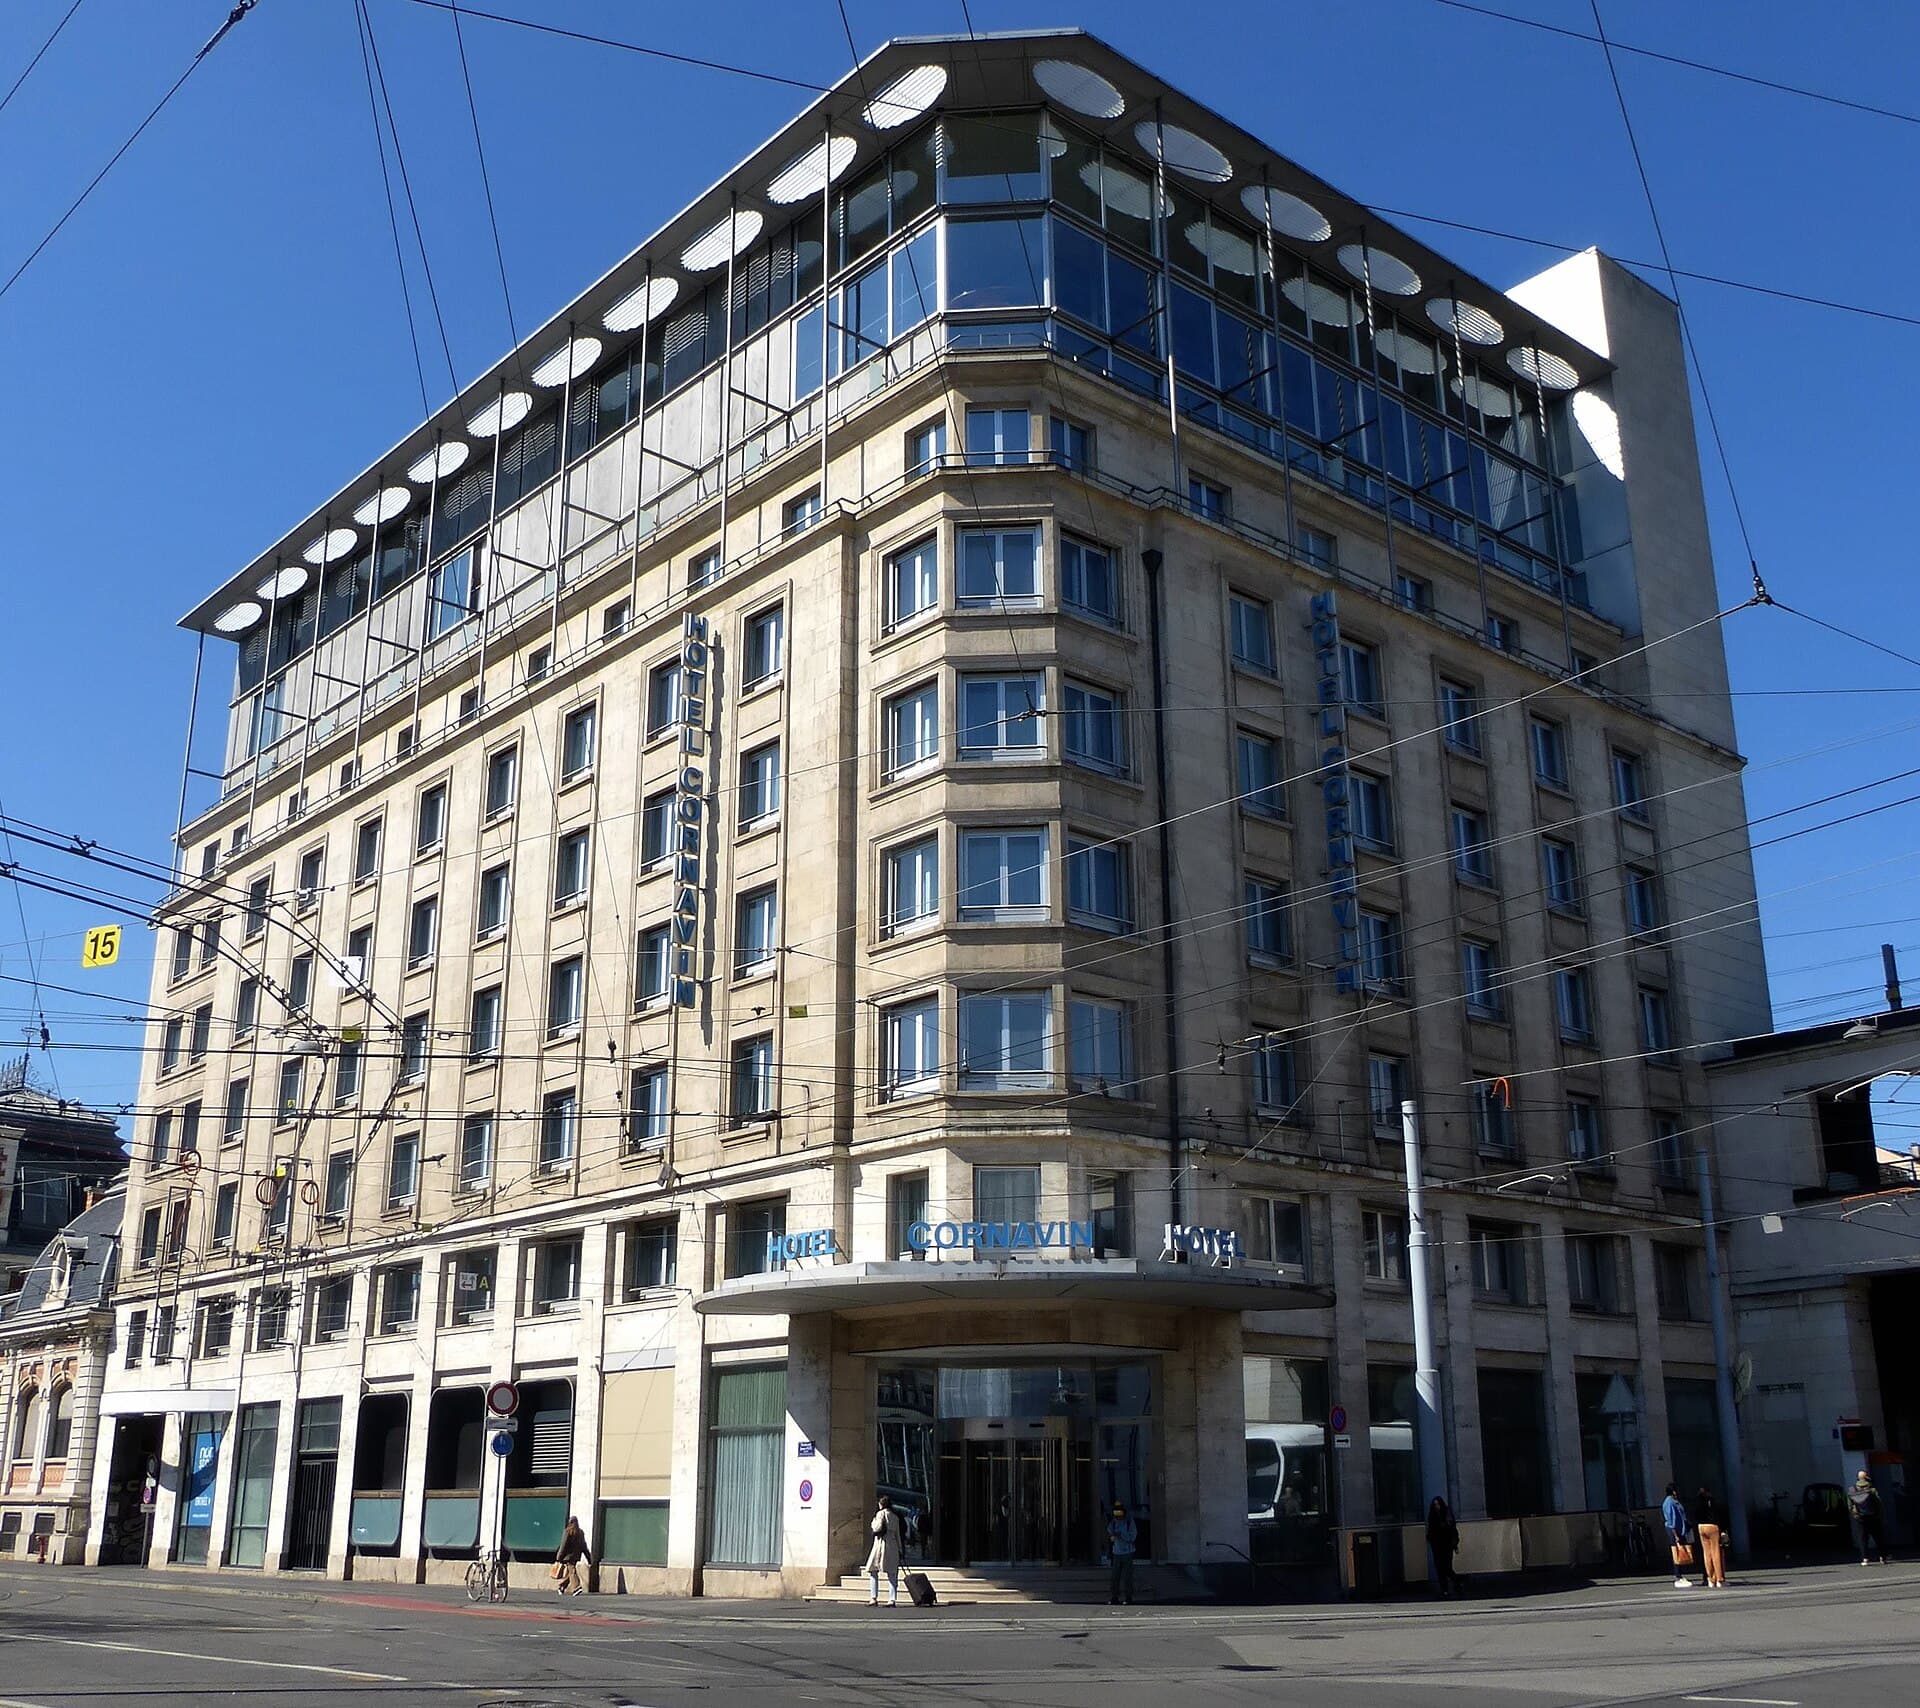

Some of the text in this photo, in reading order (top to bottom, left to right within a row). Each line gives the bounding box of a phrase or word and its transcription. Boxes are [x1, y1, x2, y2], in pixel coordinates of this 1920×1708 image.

[671, 611, 708, 1009] HOTEL CORNAVIN
[1311, 591, 1362, 994] HOTEL CORNAVIN
[90, 931, 116, 960] 15
[768, 1228, 837, 1263] HOTEL
[908, 1221, 1094, 1250] CORNAVIN
[1165, 1223, 1248, 1258] HOTEL
[479, 1275, 489, 1289] A
